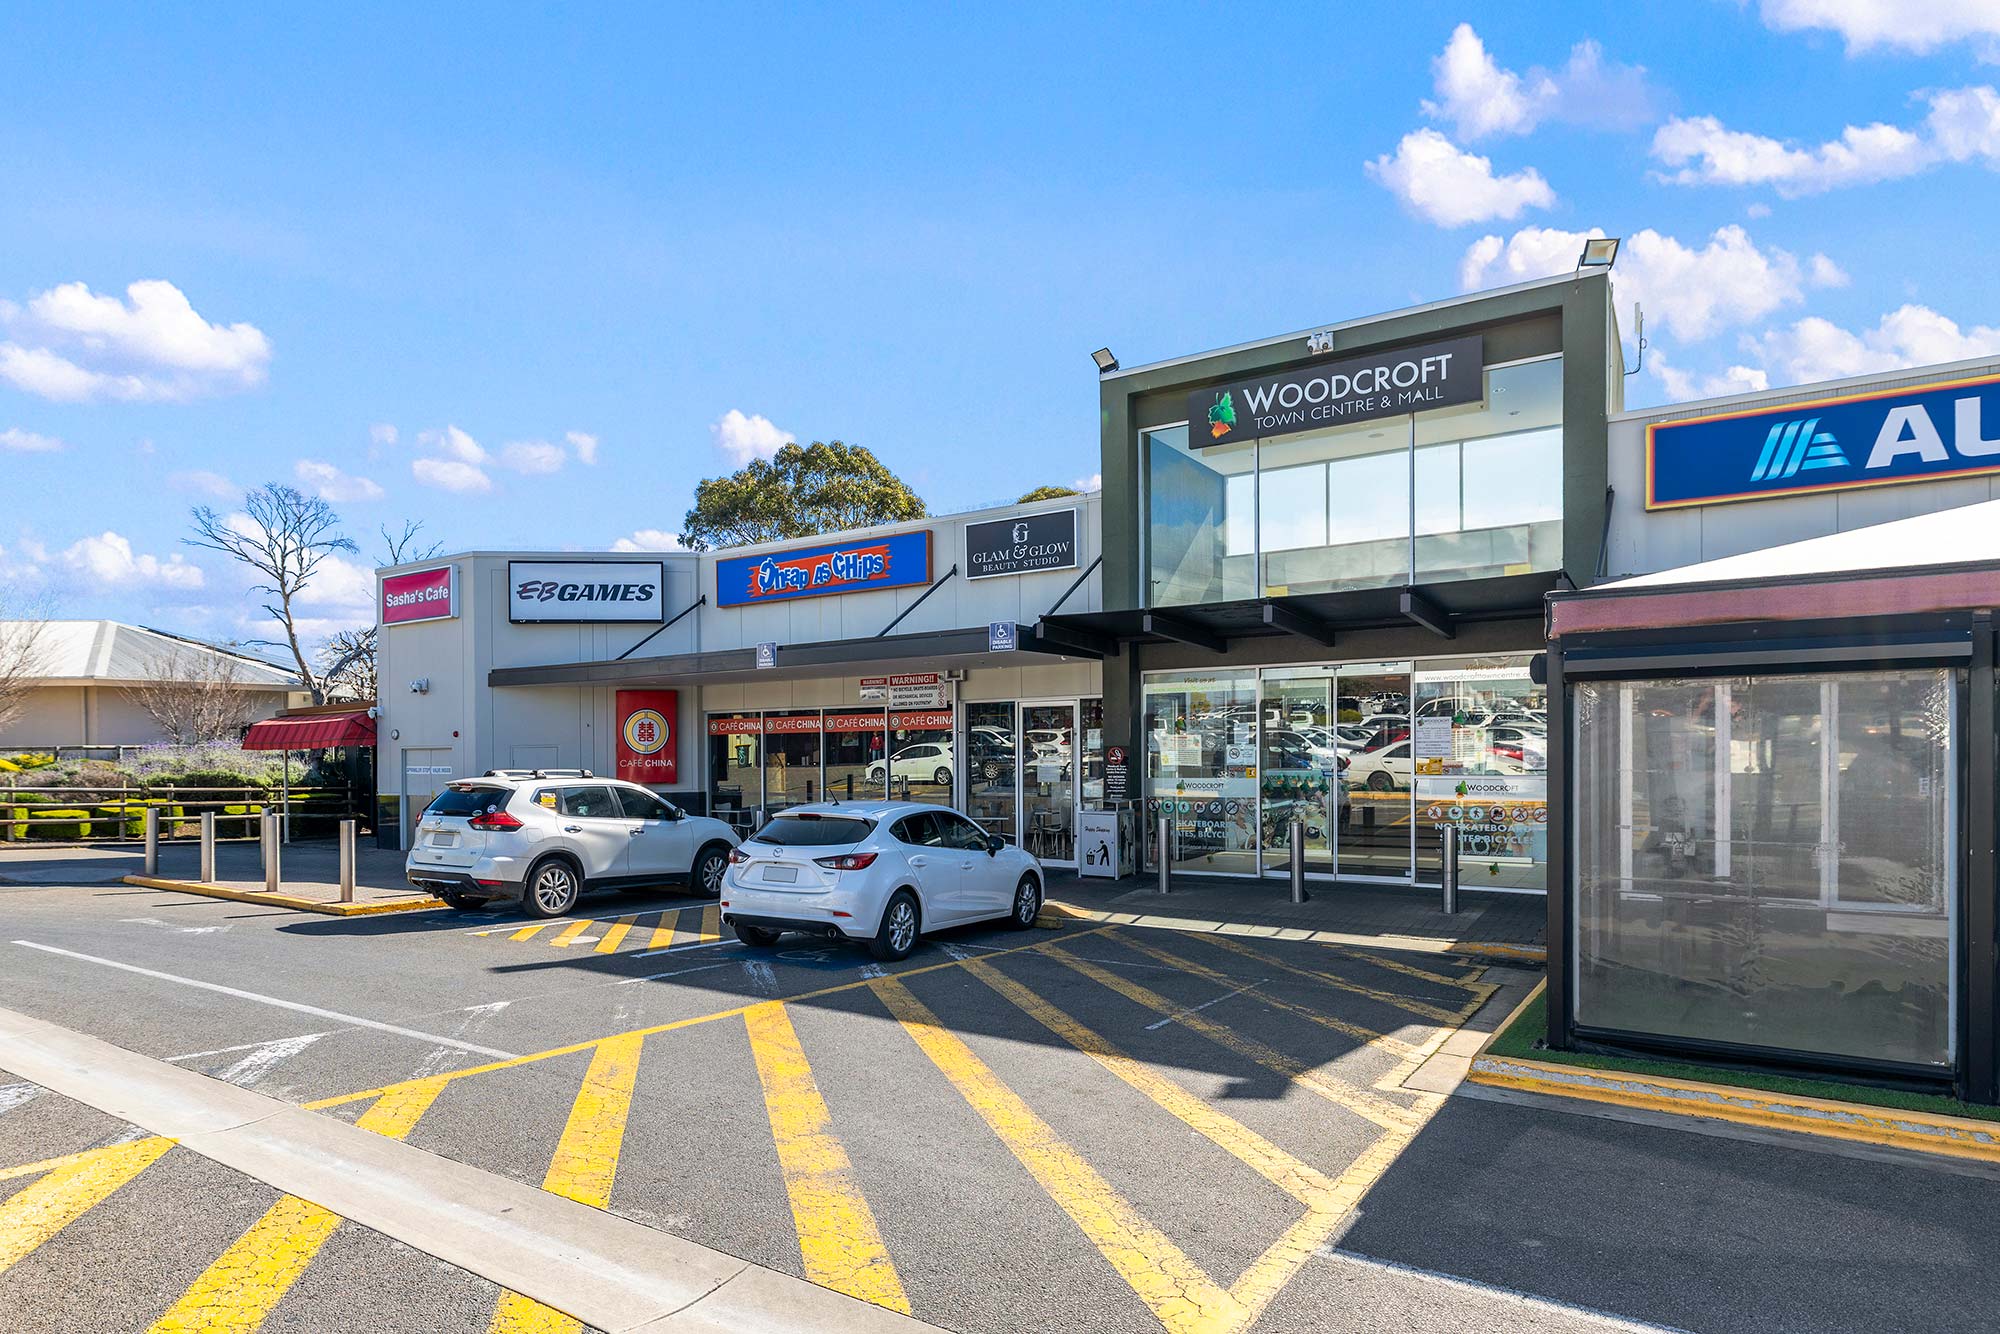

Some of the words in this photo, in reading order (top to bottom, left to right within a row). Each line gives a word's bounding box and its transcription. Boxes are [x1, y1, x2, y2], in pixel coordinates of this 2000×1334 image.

[1243, 353, 1453, 415] WOODCROFT
[1254, 410, 1305, 430] TOWN
[1310, 397, 1375, 420] CENTRE
[1380, 396, 1392, 408] &
[1398, 386, 1444, 406] MALL
[972, 549, 1010, 564] GLAM
[1013, 544, 1028, 560] &
[1029, 541, 1070, 557] GLOW
[982, 561, 1018, 572] BEAUTY
[1023, 555, 1060, 567] STUDIO
[386, 590, 424, 608] Sasha's
[426, 586, 449, 601] Cafe
[891, 674, 934, 685] WARNING!!
[719, 720, 738, 731] CAFÉ
[738, 721, 761, 731] CHINA
[775, 719, 796, 730] CAFÉ
[796, 719, 822, 729] CHINA
[836, 716, 858, 728] CAFÉ
[858, 717, 886, 727] CHINA
[902, 714, 926, 727] CAFÉ
[619, 758, 643, 768] CAFÉ
[644, 759, 673, 767] CHINA
[1467, 784, 1519, 792] WOODCROFT
